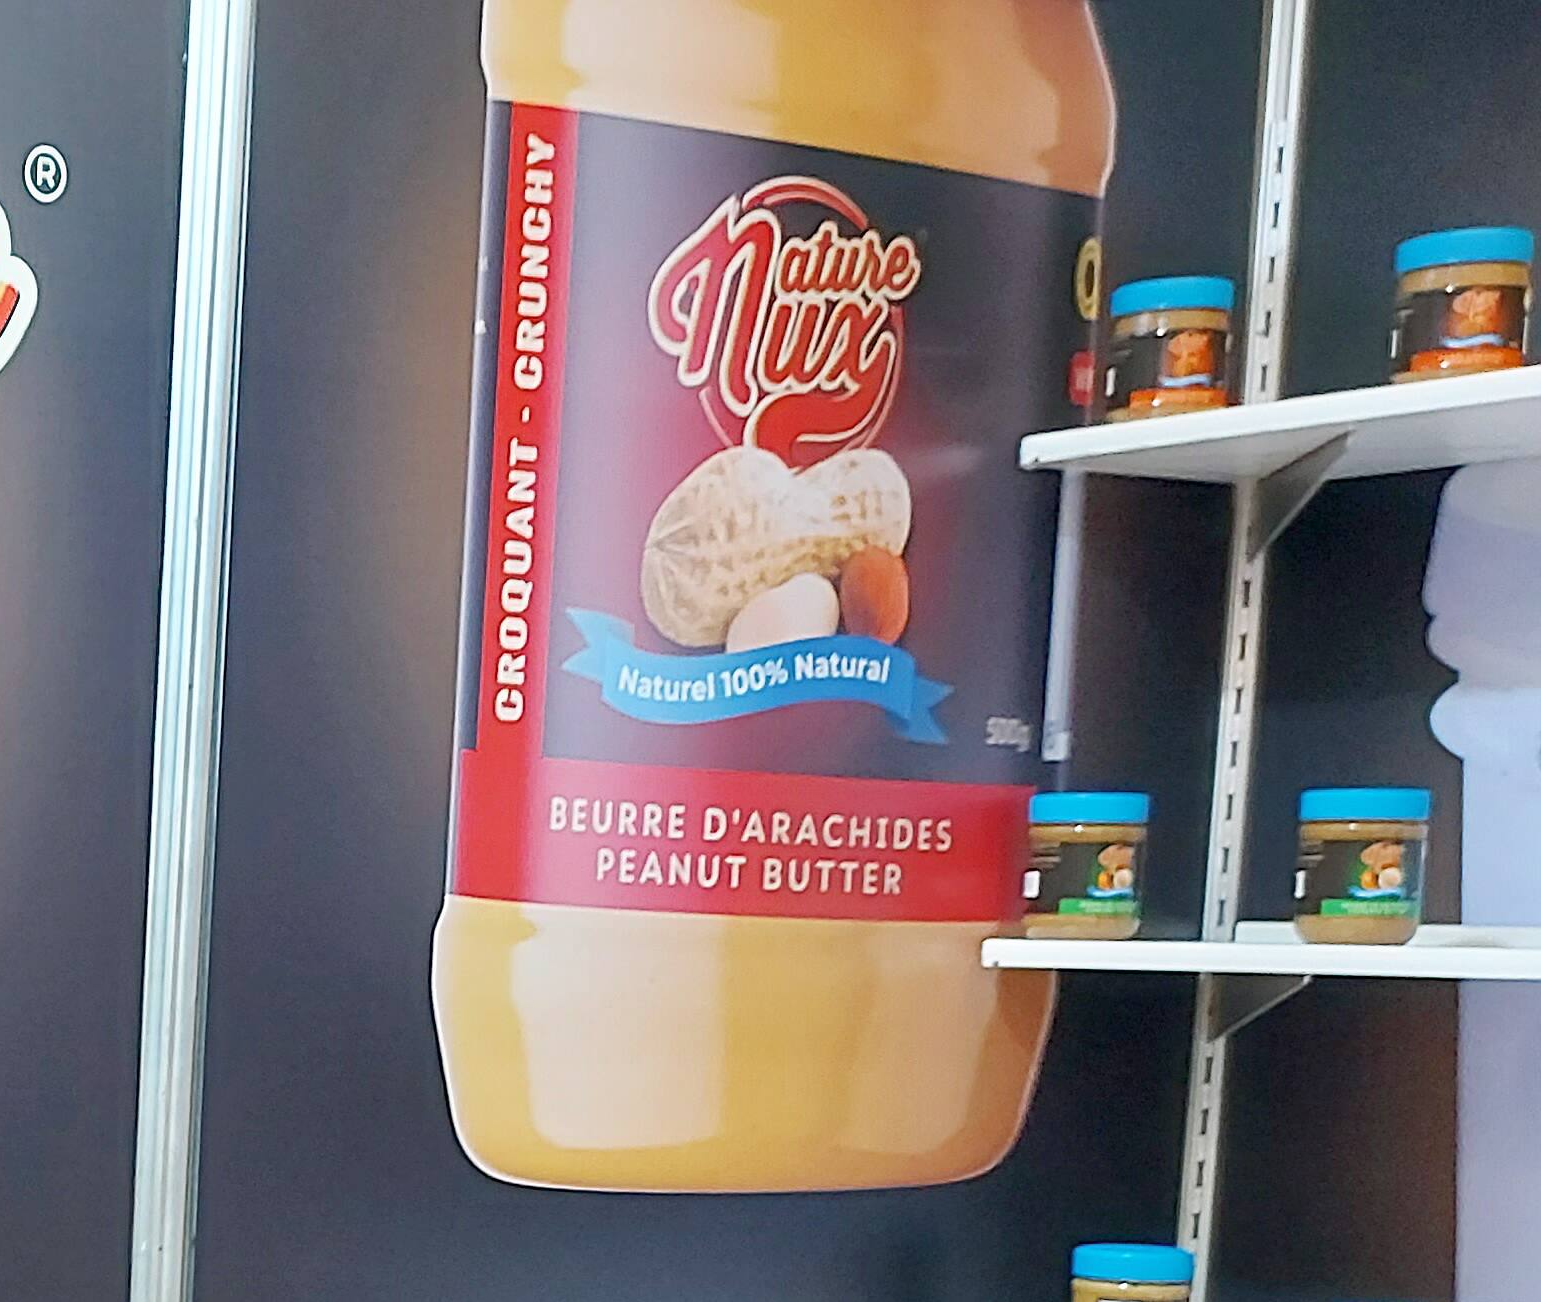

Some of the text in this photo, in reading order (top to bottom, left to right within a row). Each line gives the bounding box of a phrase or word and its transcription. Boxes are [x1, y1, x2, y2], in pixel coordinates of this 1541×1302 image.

[513, 132, 555, 391] CRUNCHY
[494, 436, 538, 722] CROQUANT
[617, 652, 891, 703] Naturel 100% Natural
[548, 796, 953, 853] BEURRE D'ARACHIDES
[596, 847, 903, 896] PEANUT BUTTER
